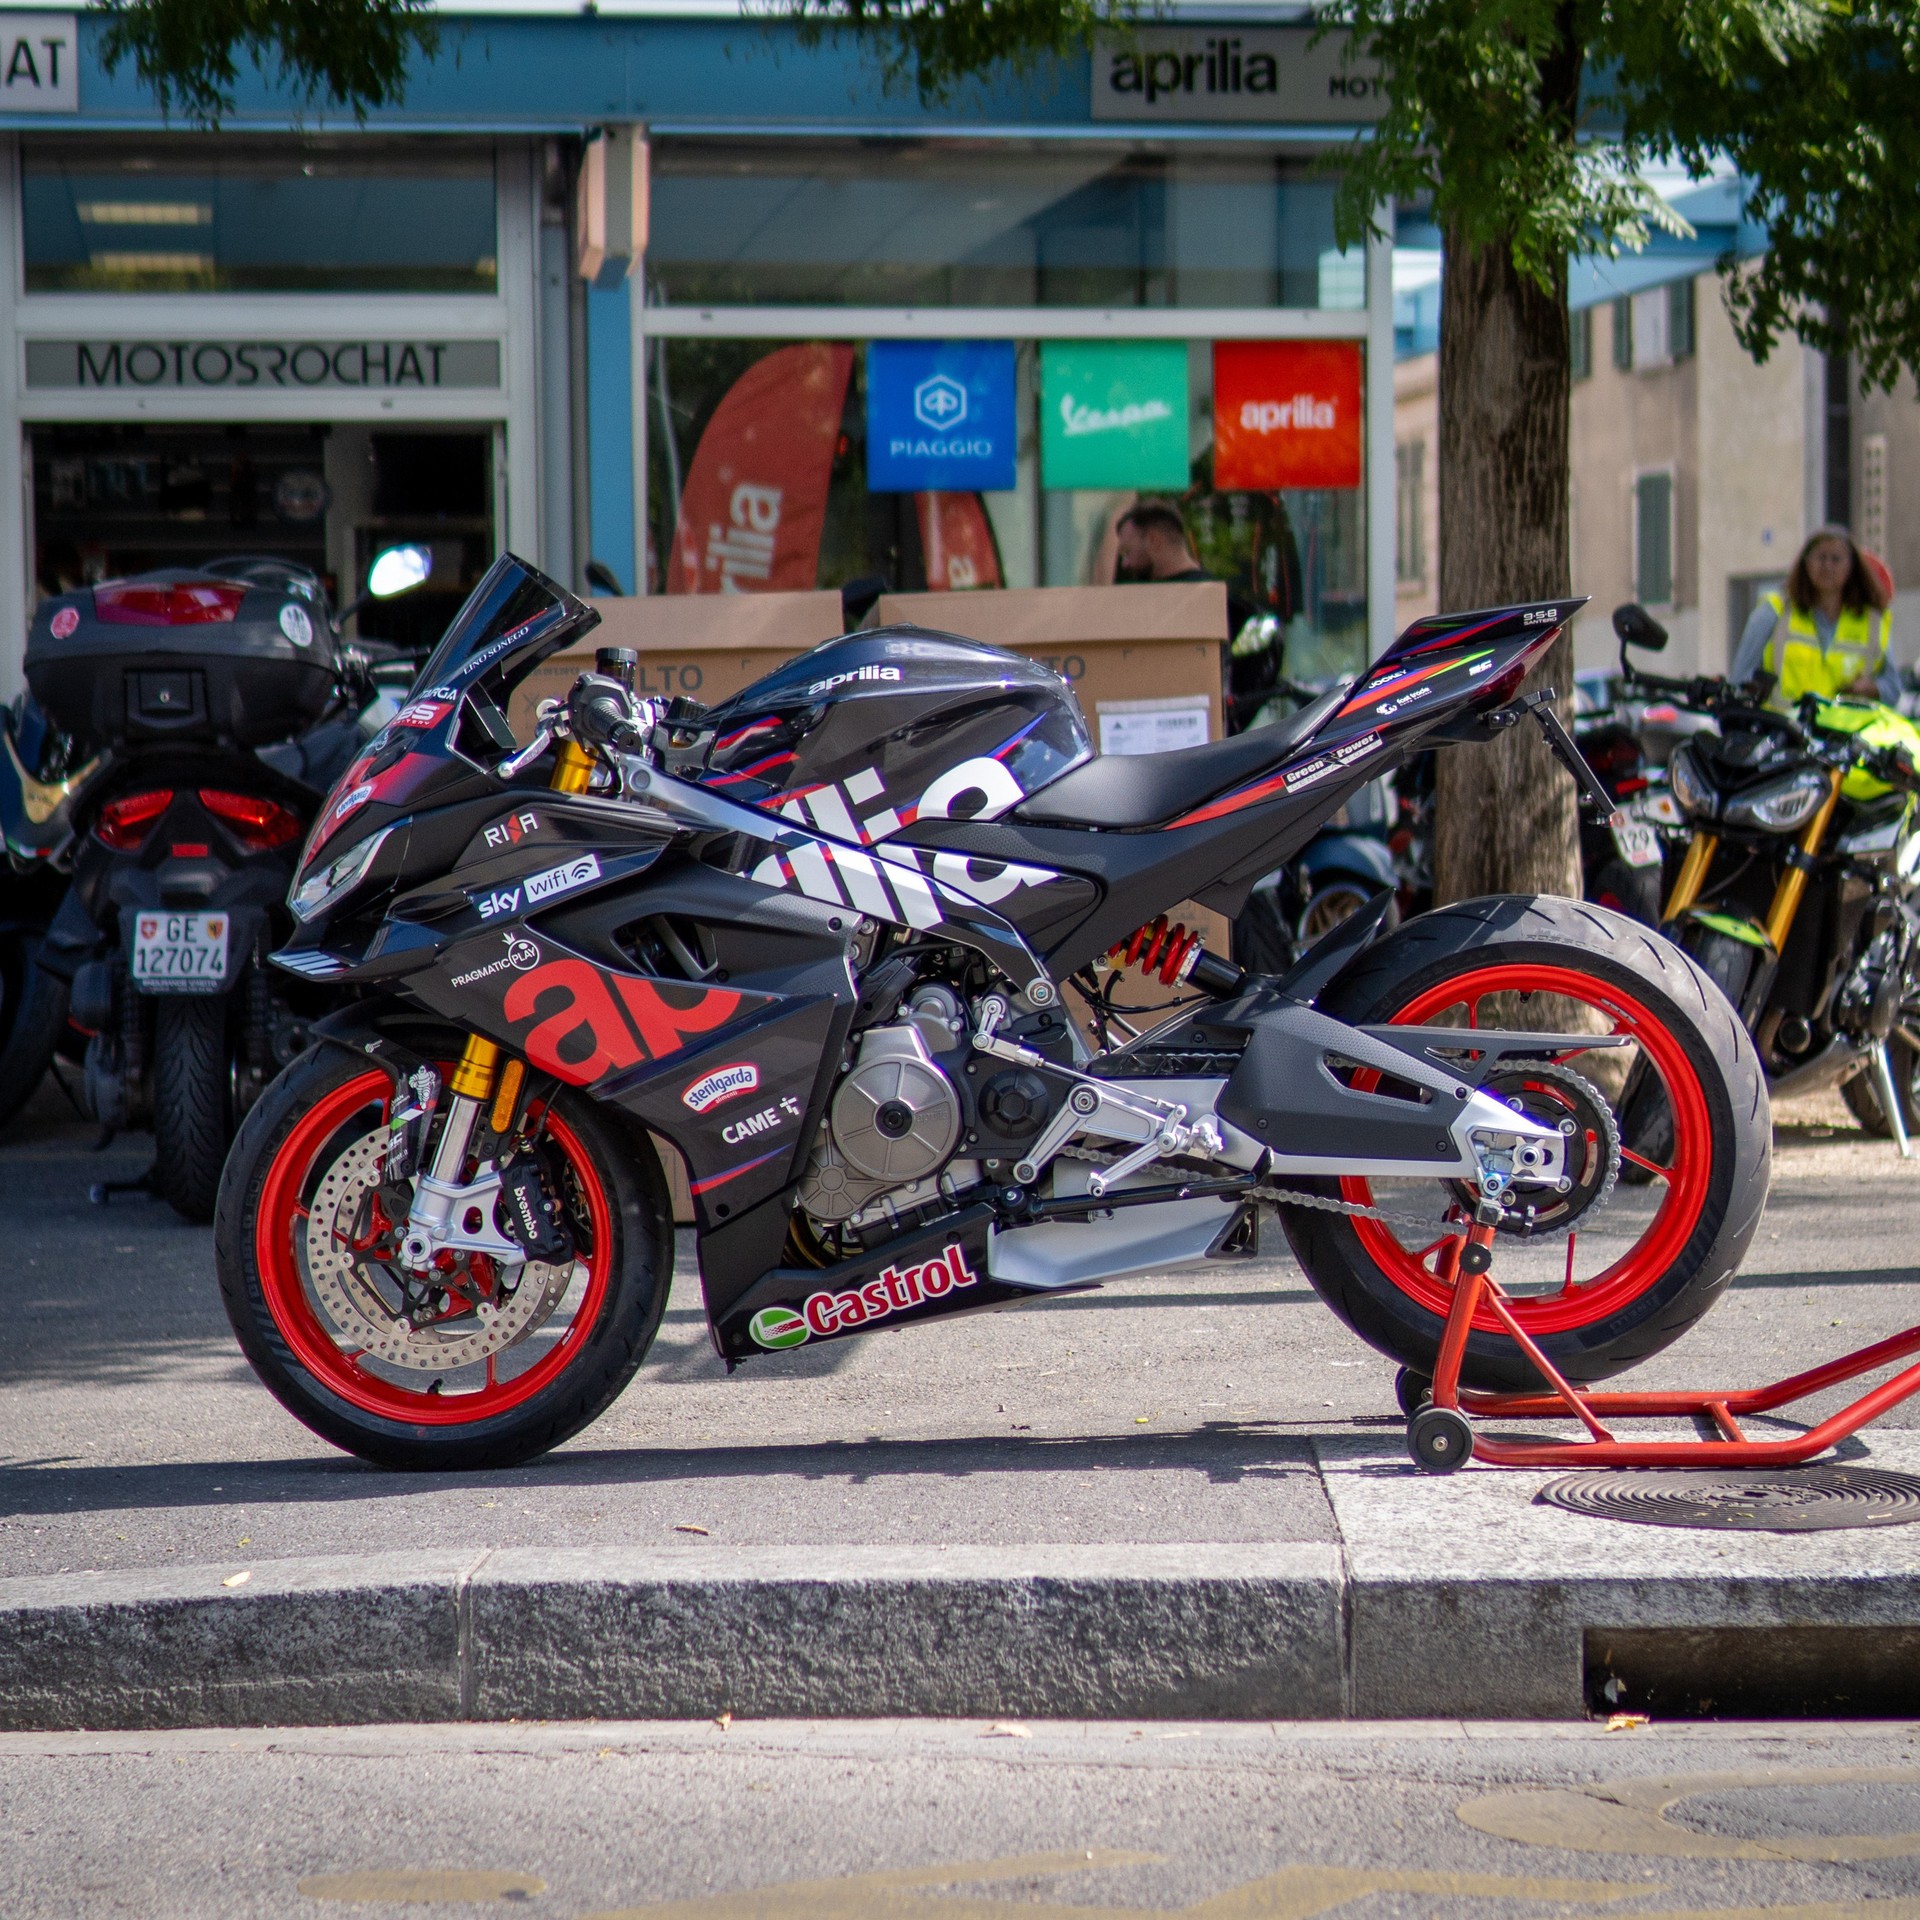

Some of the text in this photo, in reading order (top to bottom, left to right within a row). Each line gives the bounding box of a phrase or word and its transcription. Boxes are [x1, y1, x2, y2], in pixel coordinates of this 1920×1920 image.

[1111, 38, 1277, 104] aprilia
[1061, 393, 1172, 437] Vespa
[1240, 392, 1337, 435] aprilia
[890, 438, 993, 457] PIAGGIO
[1523, 616, 1558, 626] SANTERO
[463, 626, 530, 676] LINO SONEGO
[807, 665, 901, 696] aprilia
[1286, 734, 1375, 783] Green Power
[478, 869, 568, 919] sky wifi
[167, 917, 199, 943] GE
[137, 946, 223, 974] 127074
[451, 946, 536, 988] PRAGMATIC PLAY
[688, 1068, 753, 1107] sterilgarda
[721, 1107, 781, 1144] CAME
[513, 1186, 538, 1240] brembo
[805, 1245, 975, 1335] Castrol
